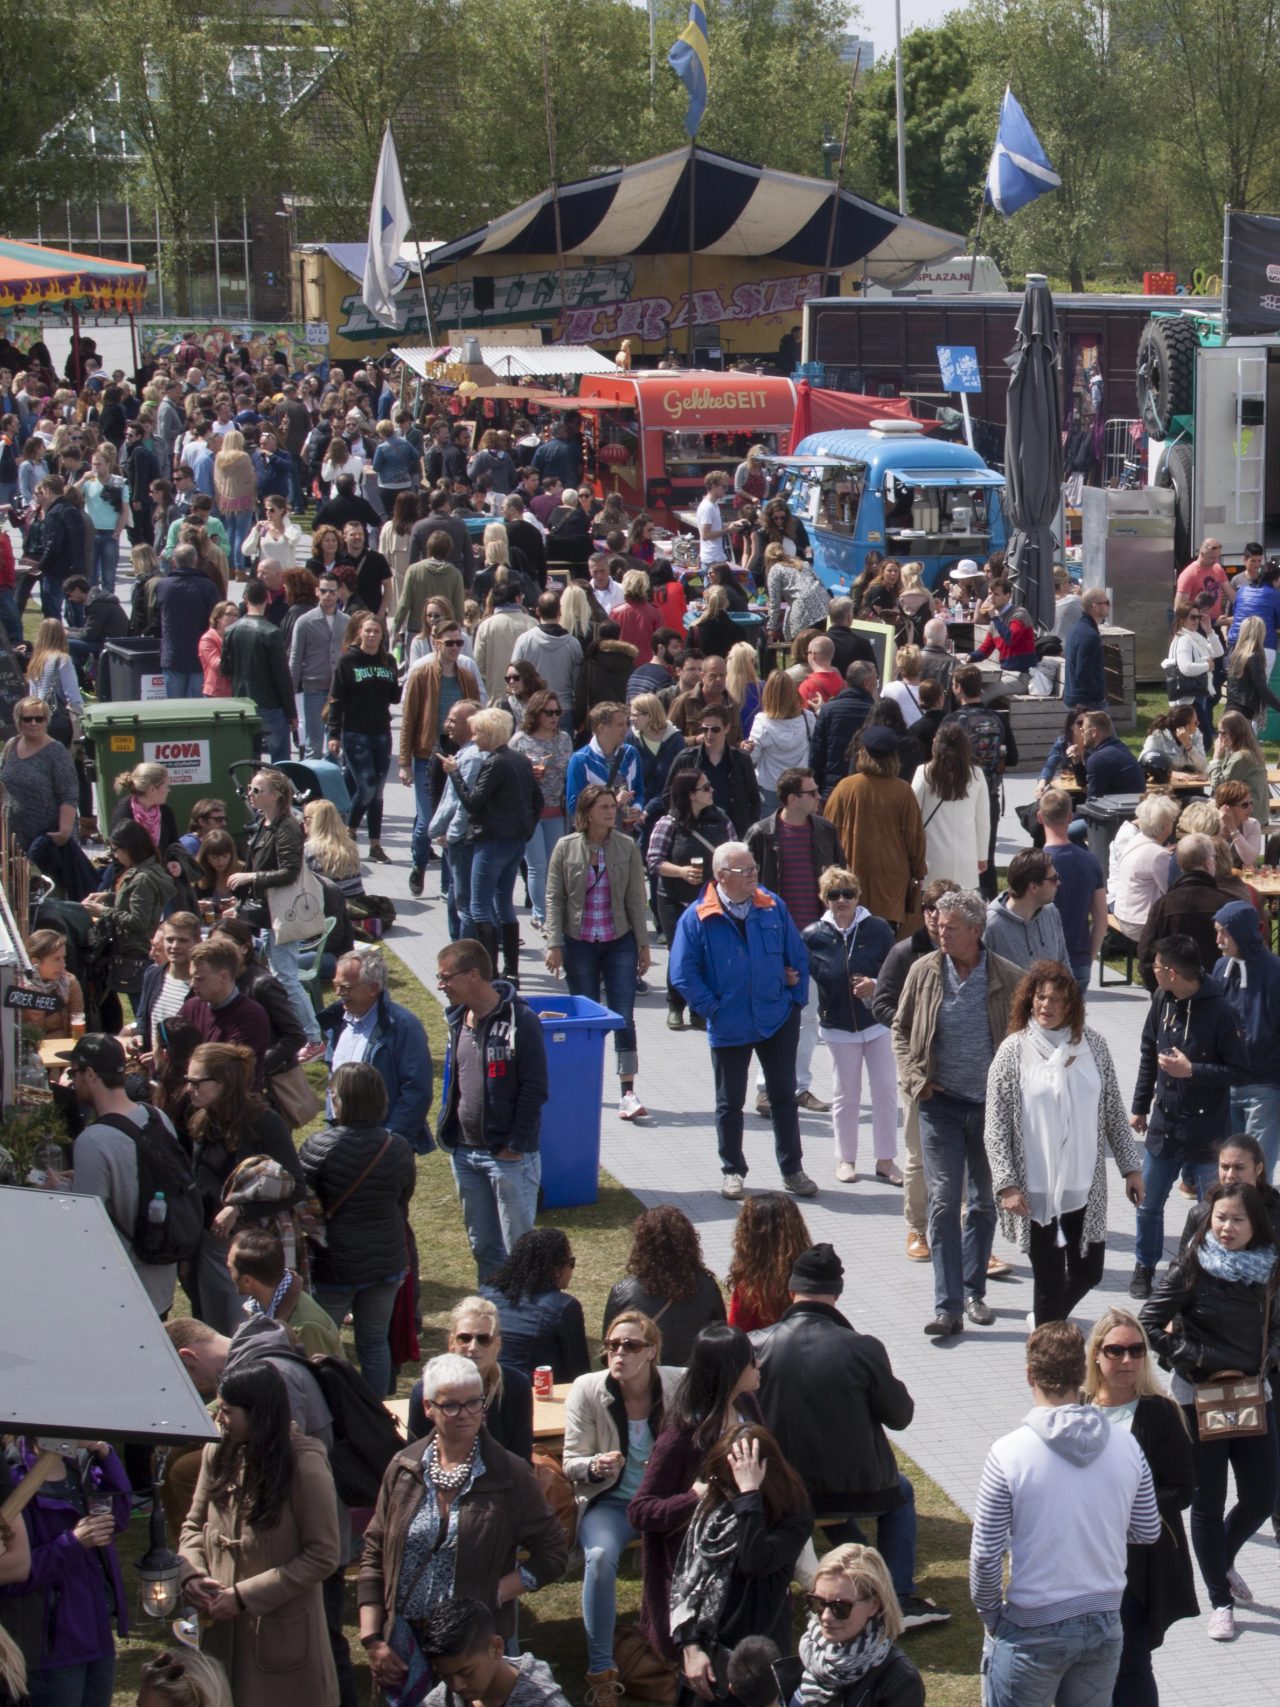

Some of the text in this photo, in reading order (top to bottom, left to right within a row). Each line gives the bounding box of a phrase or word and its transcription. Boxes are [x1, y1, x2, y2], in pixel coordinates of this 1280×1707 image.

[663, 387, 768, 419] GekkeGEIT
[155, 743, 201, 760] ICOVA
[9, 991, 57, 1010] ORDER HERE
